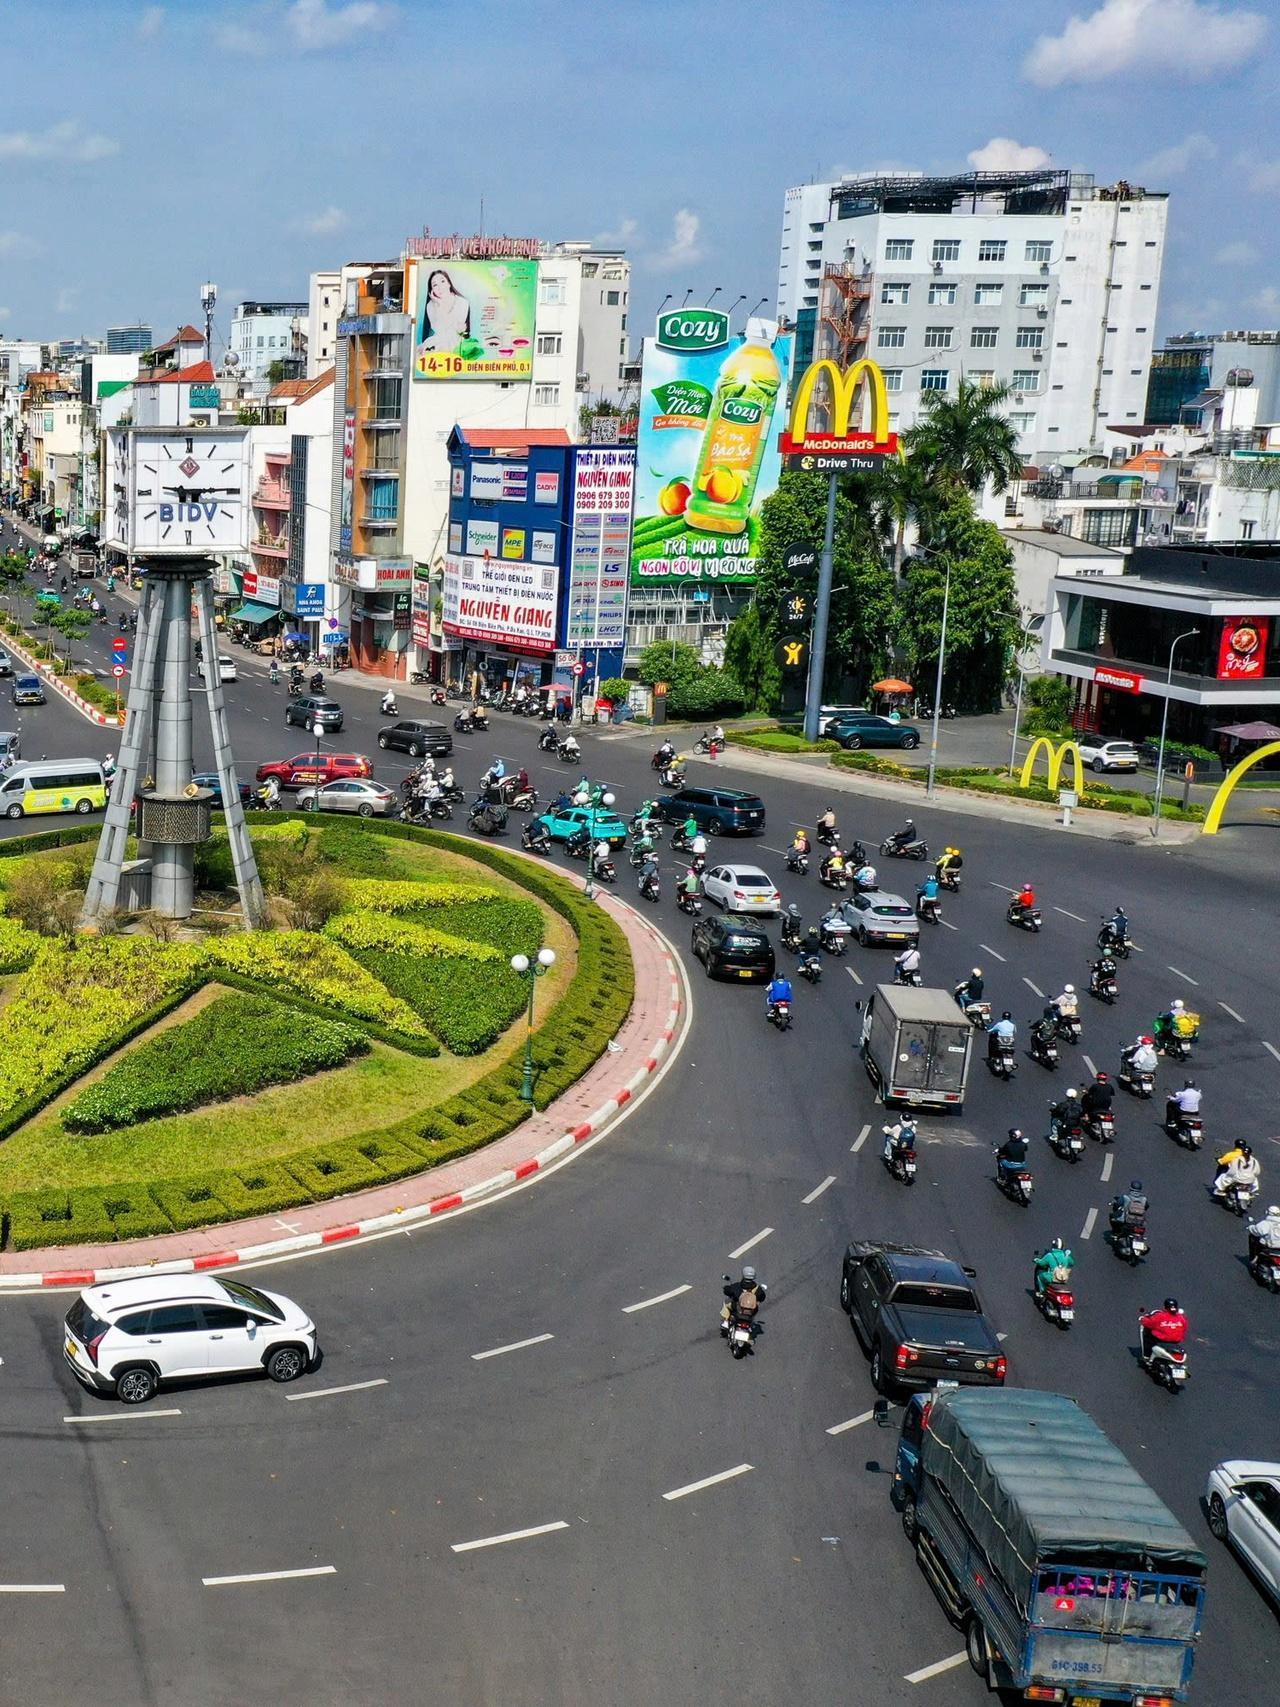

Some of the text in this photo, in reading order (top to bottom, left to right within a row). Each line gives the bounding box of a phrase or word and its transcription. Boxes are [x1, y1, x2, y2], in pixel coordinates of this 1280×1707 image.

[665, 316, 720, 342] Cozy
[419, 357, 462, 372] 14-16
[665, 396, 705, 414] Mới
[723, 401, 760, 421] Cozy
[803, 439, 875, 450] McDonald's
[817, 458, 874, 468] Drive Thru
[472, 475, 501, 484] Panasonic
[609, 471, 631, 488] GIANG
[577, 491, 630, 500] 0906 679 300
[576, 501, 630, 509] 0909 209 300
[159, 503, 218, 522] BIDV
[468, 531, 497, 545] Schneider
[663, 532, 750, 555] TRÀ HOA QUẢ
[641, 560, 667, 573] NGON
[395, 569, 411, 580] ANH
[459, 596, 553, 629] NGUYỄN GIANG
